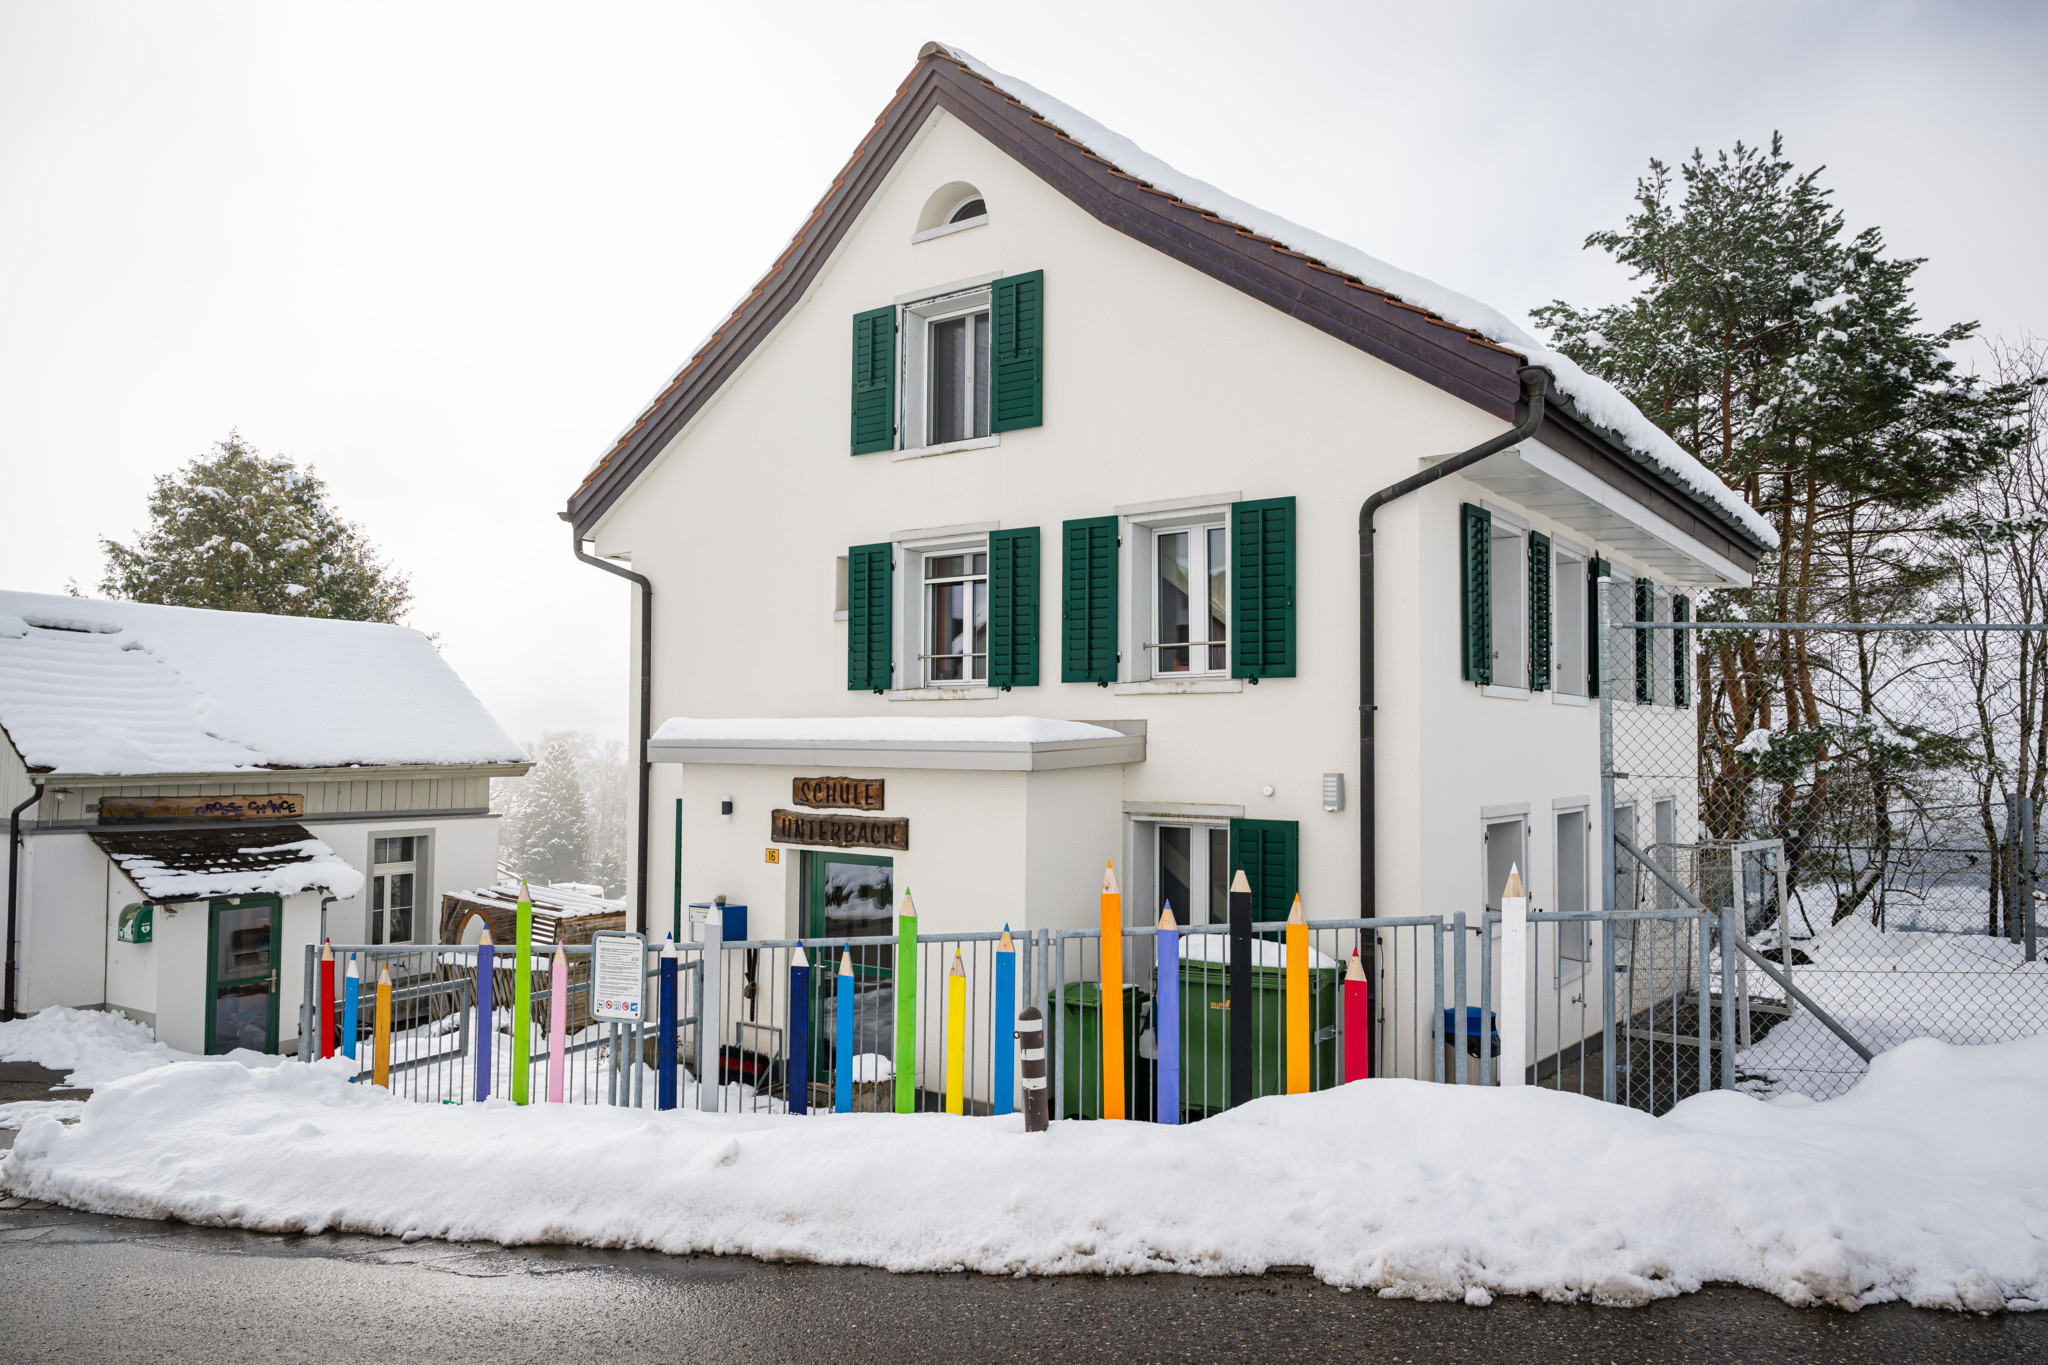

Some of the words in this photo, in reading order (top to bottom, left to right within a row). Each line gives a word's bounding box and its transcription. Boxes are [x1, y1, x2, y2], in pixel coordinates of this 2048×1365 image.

[800, 782, 875, 805] SCHULE
[248, 800, 296, 814] CHANCE
[781, 818, 896, 844] UNTERBACH
[768, 850, 776, 862] 16
